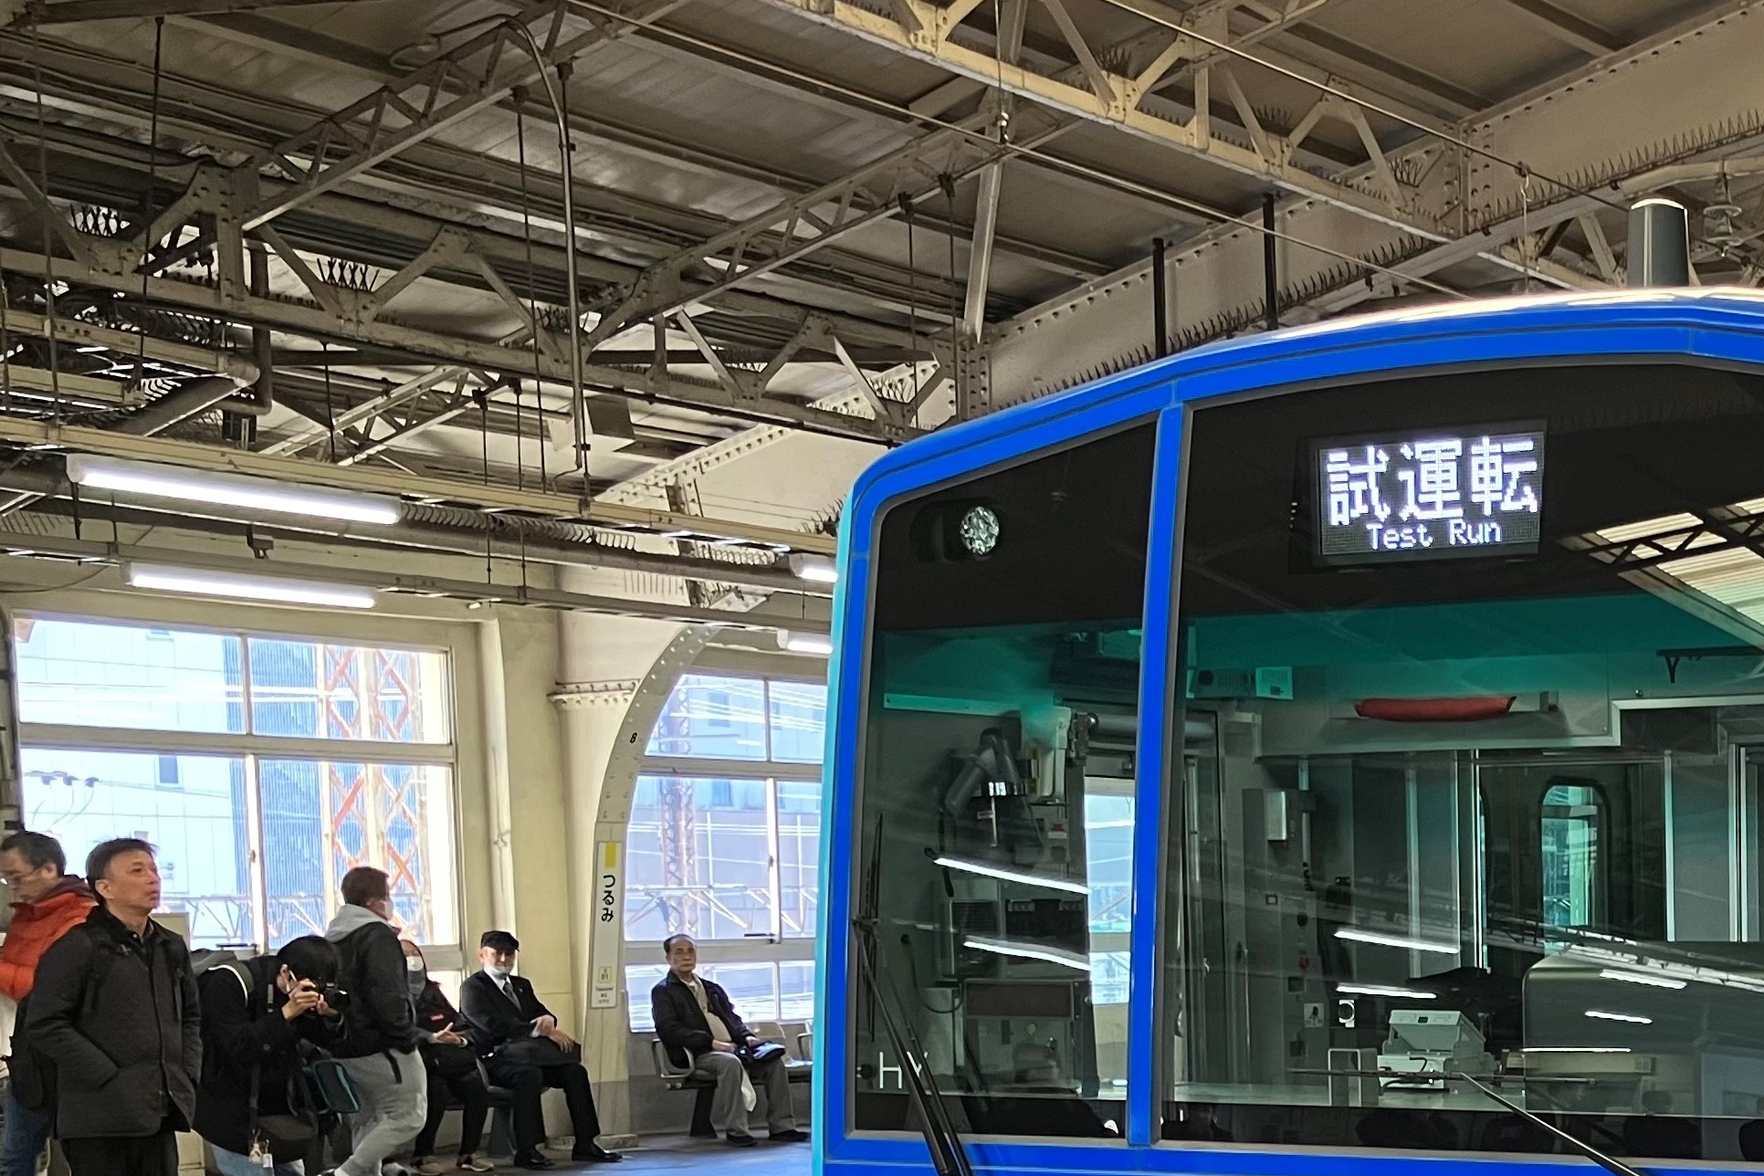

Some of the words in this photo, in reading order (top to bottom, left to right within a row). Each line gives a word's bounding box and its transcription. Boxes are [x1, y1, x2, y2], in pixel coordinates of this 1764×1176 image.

[1326, 436, 1538, 525] 試運転
[1366, 523, 1434, 550] Test
[1449, 518, 1502, 545] Run
[601, 874, 616, 923] つるみ
